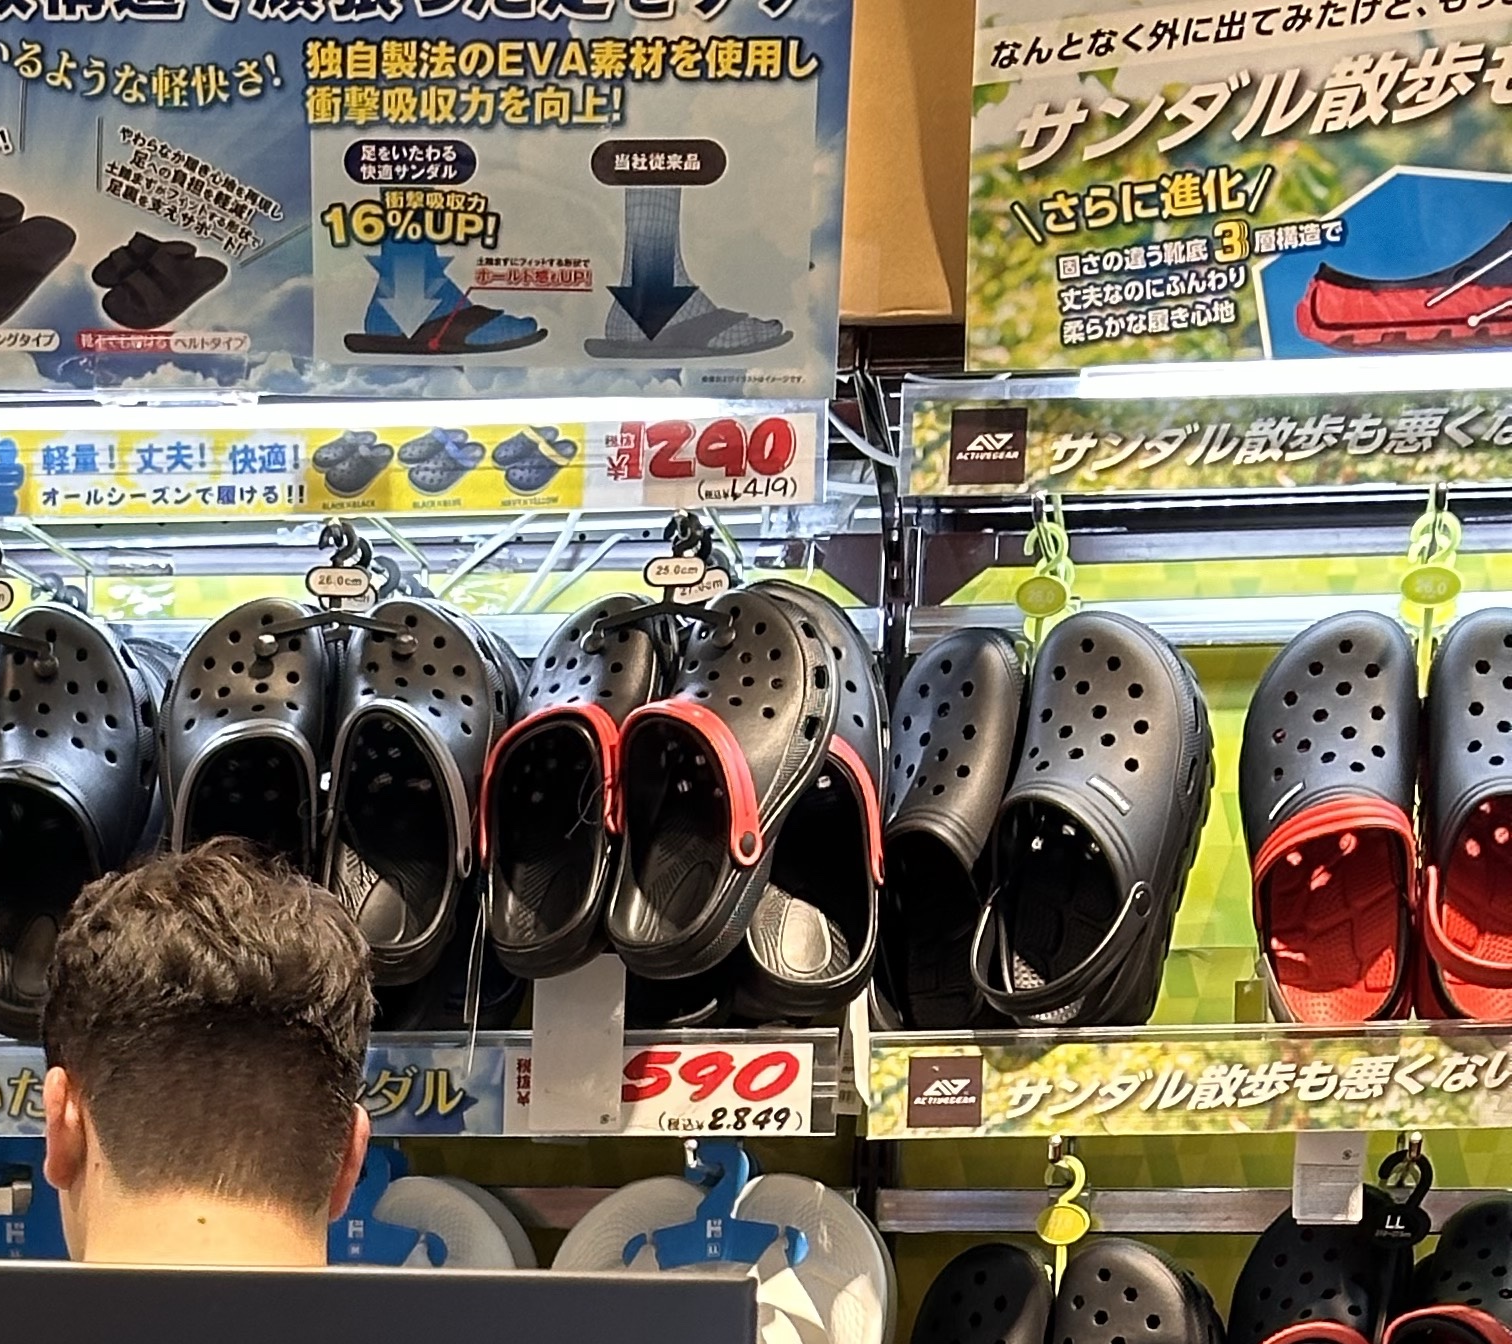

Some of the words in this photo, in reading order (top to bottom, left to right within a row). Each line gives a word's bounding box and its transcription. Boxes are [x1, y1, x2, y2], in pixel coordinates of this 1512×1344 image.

[990, 0, 1510, 70] なんとなく外に出てみたけど、
[303, 37, 821, 80] 独自製法のEVA素材を使用し
[304, 83, 624, 127] 衝撃吸収力を向上!
[360, 145, 458, 162] 足をいたわる
[360, 163, 458, 180] 快適サンダル
[613, 153, 702, 172] 当社従来品
[385, 191, 489, 213] 衝撃吸収力
[1041, 169, 1250, 235] さらに進化
[322, 203, 501, 248] 16%UP!
[1059, 266, 1247, 312] 丈夫なのにふんわり
[1060, 301, 1236, 346] 柔らかな履き心地
[42, 443, 116, 475] 軽量!
[135, 442, 206, 474] 丈夫!
[228, 442, 301, 475] 快適!
[41, 484, 306, 507] オールシーズンで履ける!!
[622, 1049, 801, 1103] 590
[1384, 1214, 1406, 1229] LL
